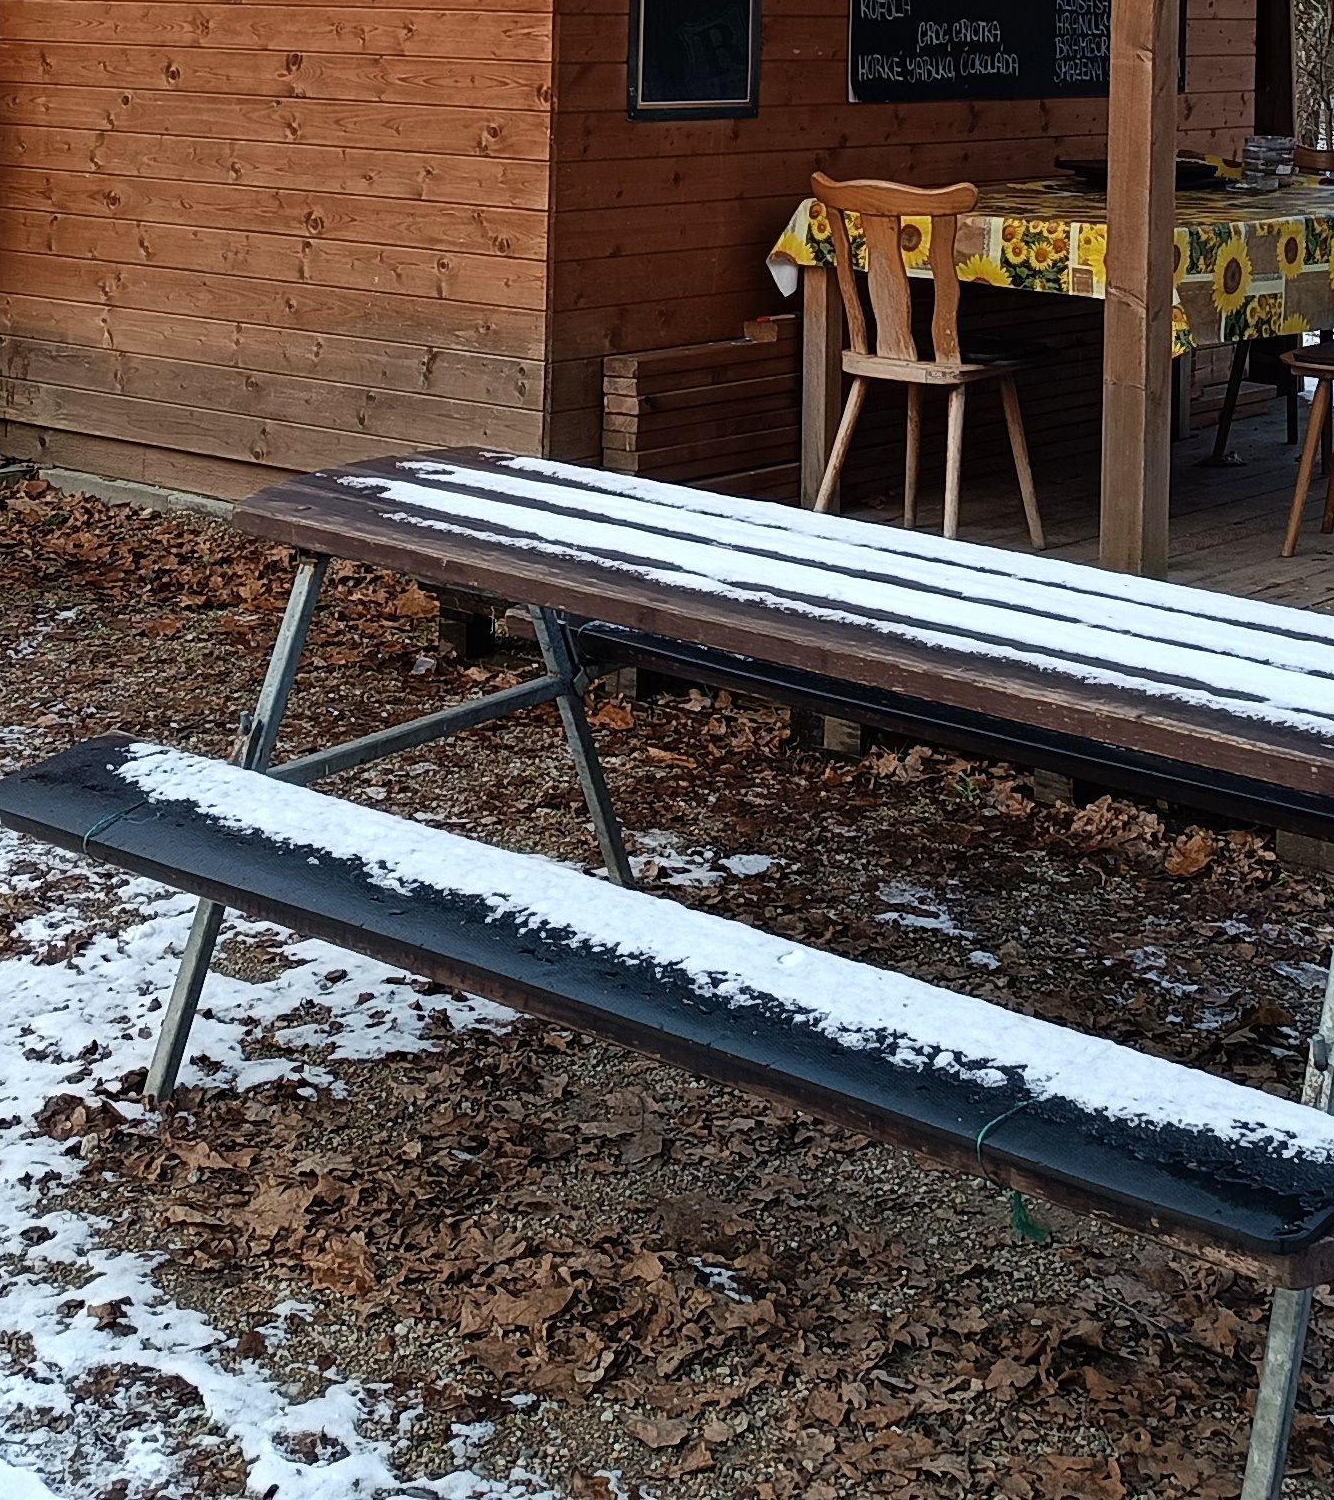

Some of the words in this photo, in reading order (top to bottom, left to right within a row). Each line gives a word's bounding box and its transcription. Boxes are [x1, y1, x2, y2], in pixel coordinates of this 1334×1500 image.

[1054, 36, 1109, 59] BRAMBOR
[858, 51, 903, 82] HORKÉ
[960, 44, 1019, 77] ČOKOLÁDA
